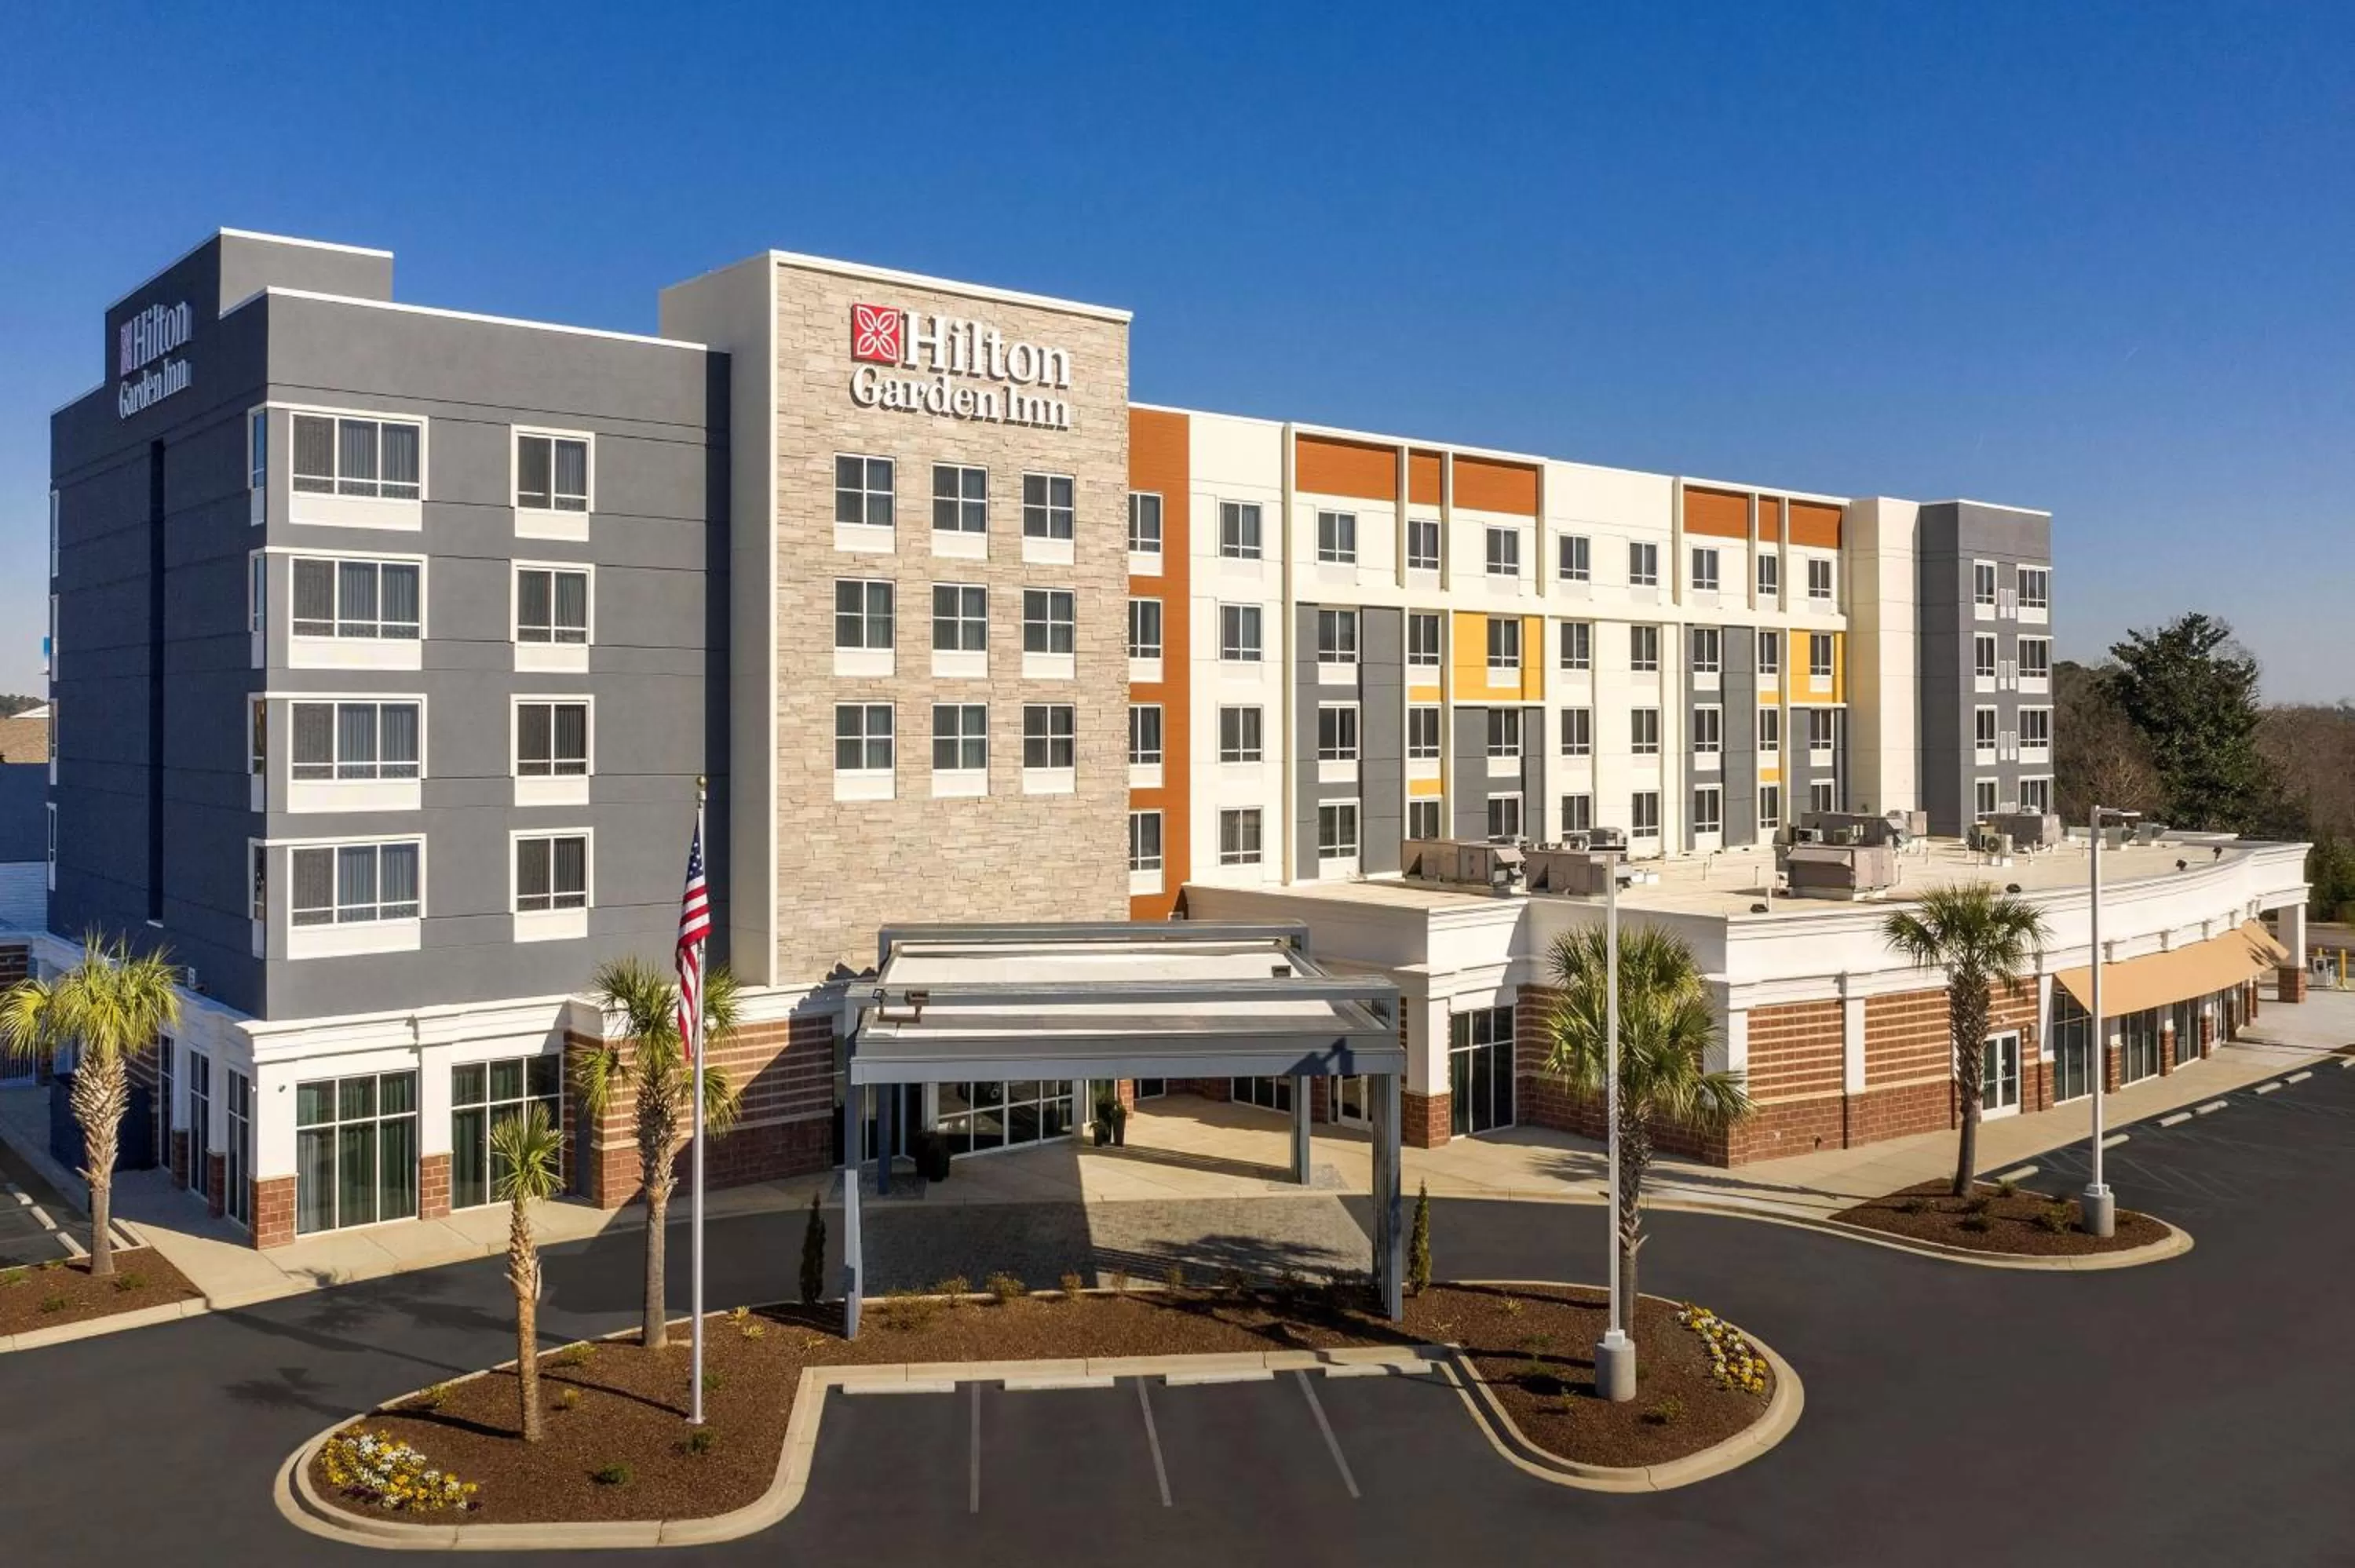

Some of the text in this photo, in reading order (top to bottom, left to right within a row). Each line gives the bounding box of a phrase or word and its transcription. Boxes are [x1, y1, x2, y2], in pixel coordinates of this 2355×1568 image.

[133, 301, 190, 370] Hilton
[903, 312, 1071, 388] Hilton
[119, 358, 191, 419] Garden Inn
[851, 366, 1070, 430] Garden Inn
